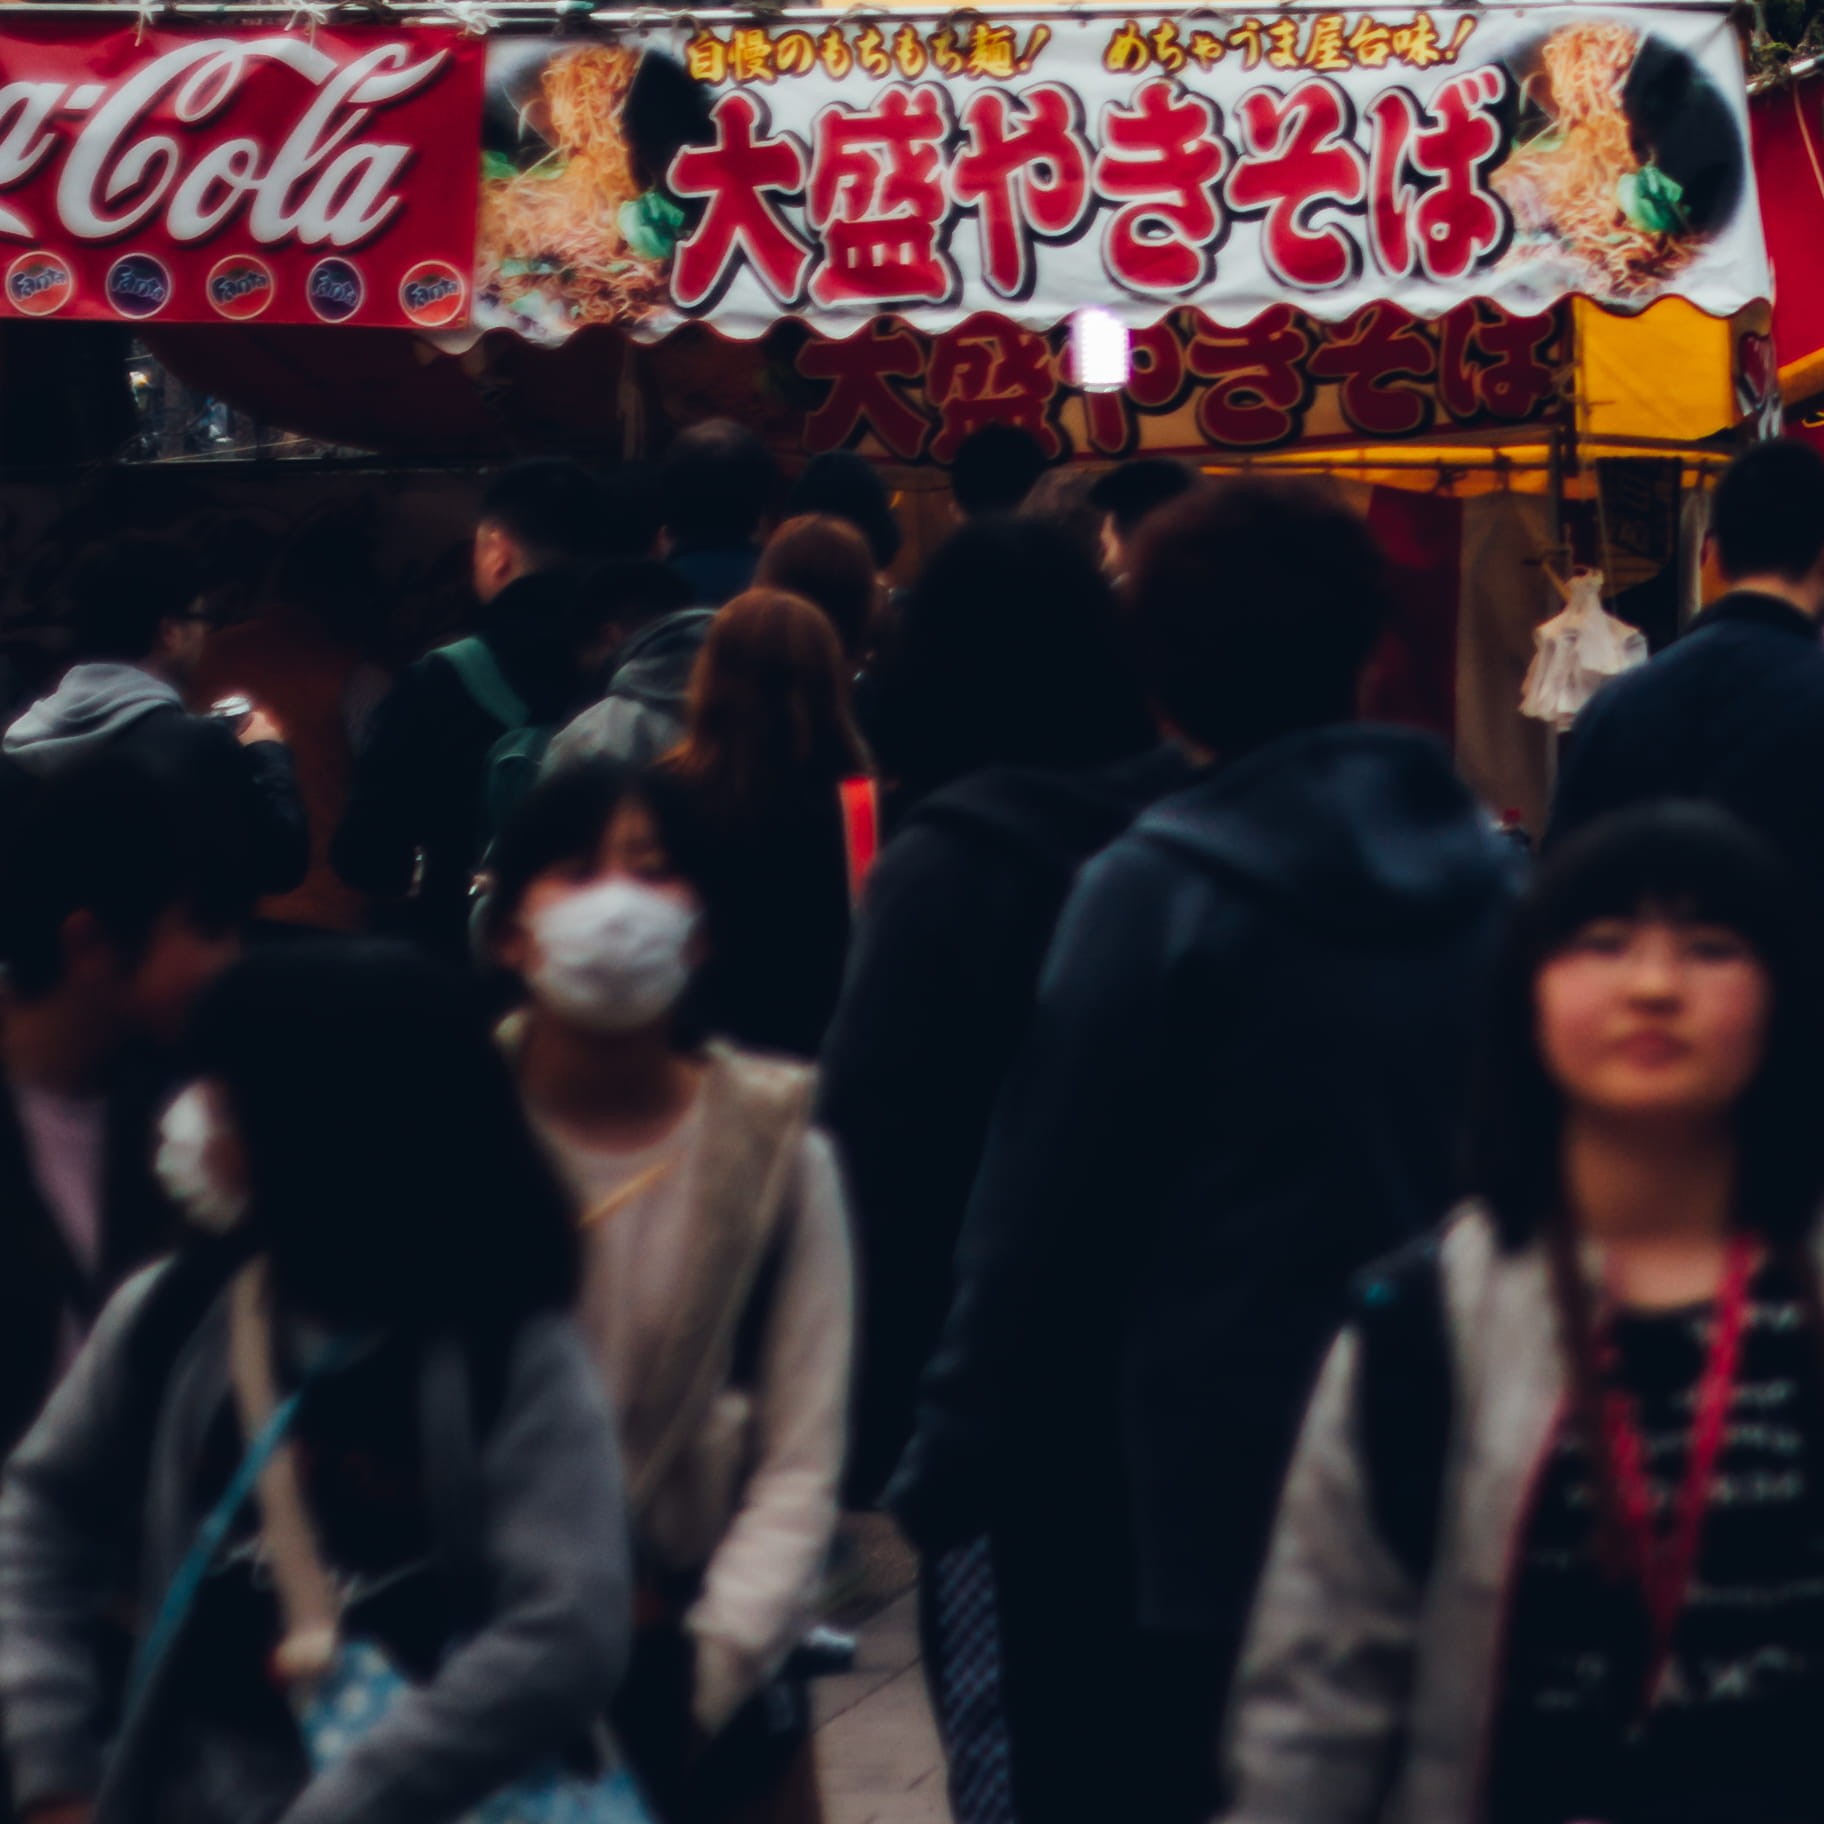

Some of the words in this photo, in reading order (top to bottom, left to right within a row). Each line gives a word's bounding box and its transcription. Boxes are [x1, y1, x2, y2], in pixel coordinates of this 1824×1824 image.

[672, 63, 1514, 313] 大盛やきそば
[10, 267, 67, 299] Fanta
[211, 270, 268, 305] Fanta
[404, 278, 458, 311] Fanta
